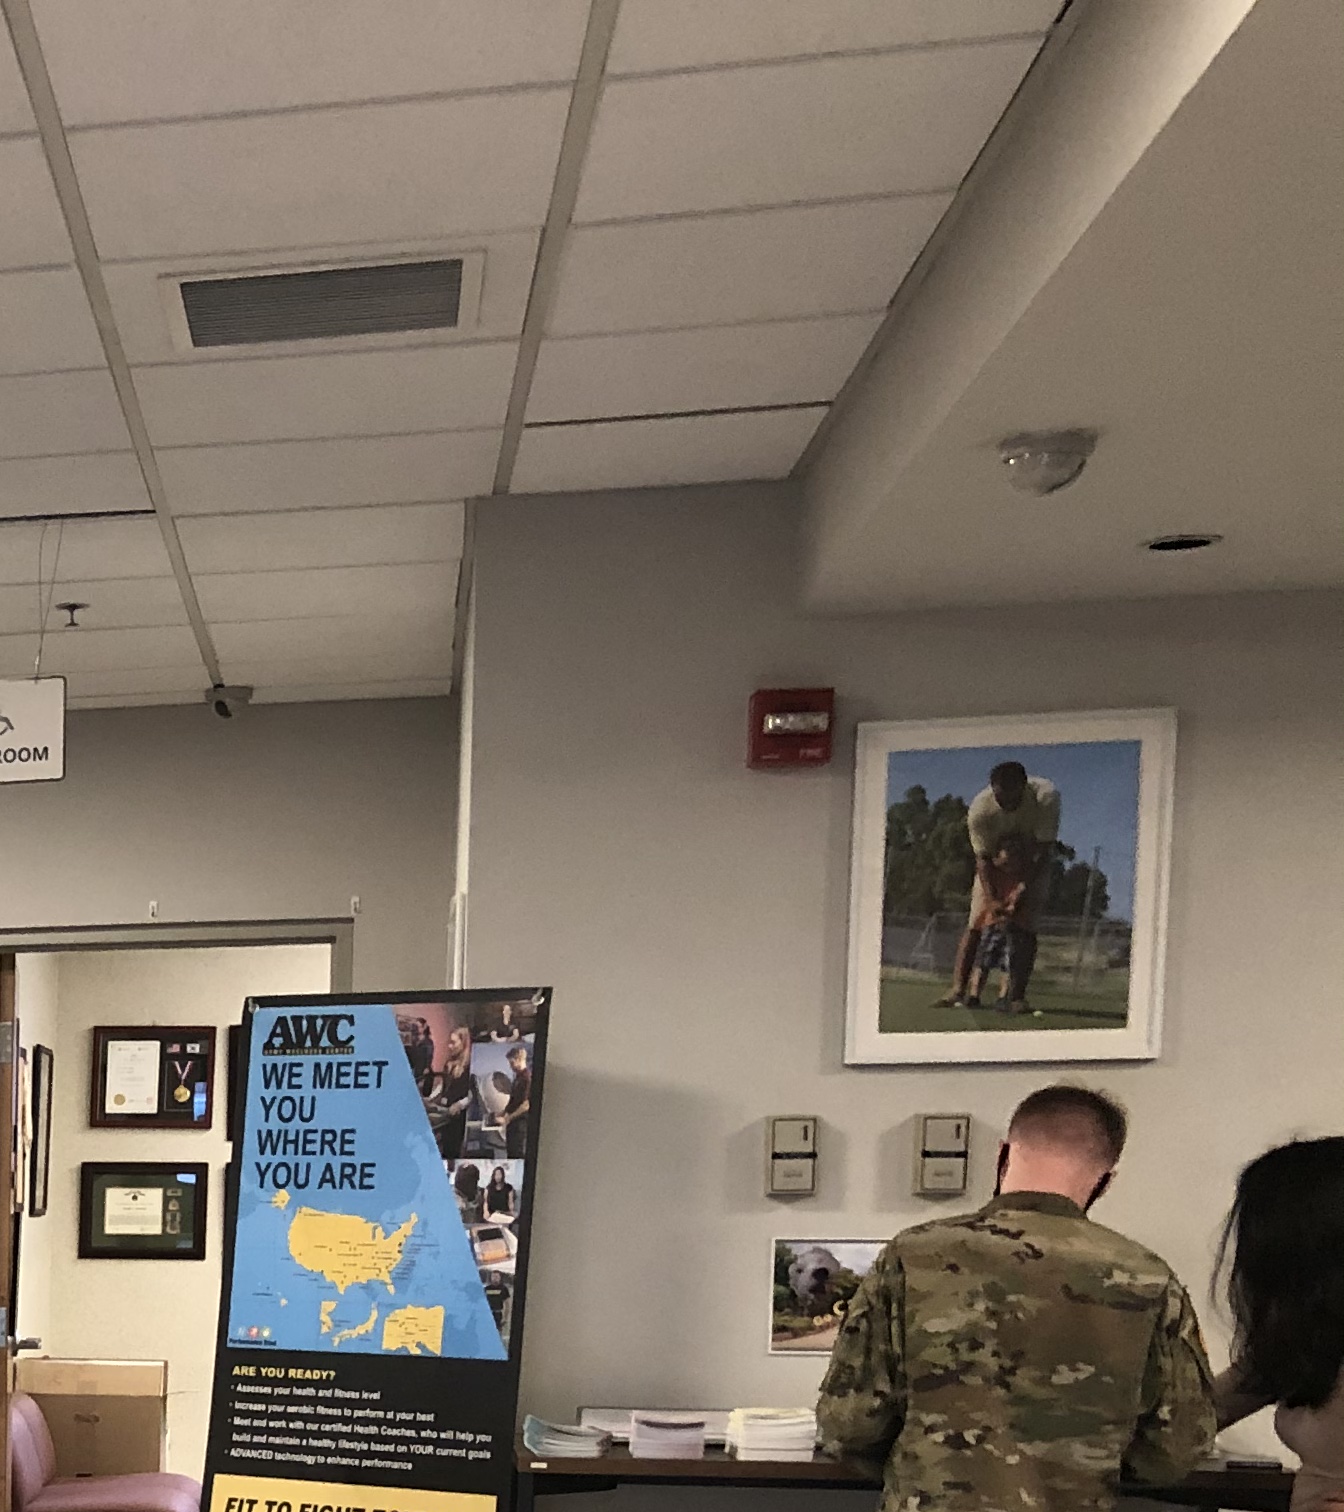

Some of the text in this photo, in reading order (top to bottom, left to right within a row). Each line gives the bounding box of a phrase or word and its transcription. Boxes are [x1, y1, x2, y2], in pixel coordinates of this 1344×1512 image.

[263, 1014, 355, 1049] AWC
[262, 1060, 389, 1090] WE MEET
[260, 1095, 317, 1123] YOU
[257, 1128, 357, 1156] WHERE
[254, 1162, 376, 1190] YOU ARE
[232, 1365, 336, 1381] ARE YOU READY?
[274, 1386, 291, 1396] your
[293, 1386, 316, 1396] health
[317, 1388, 333, 1397] and
[334, 1388, 360, 1399] fitness
[361, 1390, 381, 1400] level
[234, 1401, 266, 1411] Increase
[268, 1404, 285, 1413] your
[316, 1405, 342, 1416] fitness
[343, 1407, 352, 1416] to
[353, 1408, 385, 1419] perform
[386, 1411, 394, 1419] at
[396, 1412, 415, 1422] your
[233, 1416, 251, 1426] Meet
[252, 1418, 267, 1427] and
[268, 1418, 287, 1428] work
[289, 1420, 305, 1430] with
[306, 1422, 319, 1430] our
[353, 1424, 379, 1434] Health
[420, 1429, 438, 1438] who
[439, 1430, 454, 1440] will
[455, 1431, 474, 1443] help
[475, 1434, 492, 1444] you
[230, 1448, 413, 1470] ADVANCED technology to enhance performance
[232, 1432, 251, 1442] build
[252, 1434, 267, 1443] and
[268, 1434, 301, 1445] maintain
[308, 1437, 336, 1449] healthy
[370, 1441, 395, 1452] based
[396, 1445, 408, 1453] on
[409, 1444, 434, 1455] YOUR
[435, 1447, 466, 1457] current
[467, 1449, 491, 1460] goals
